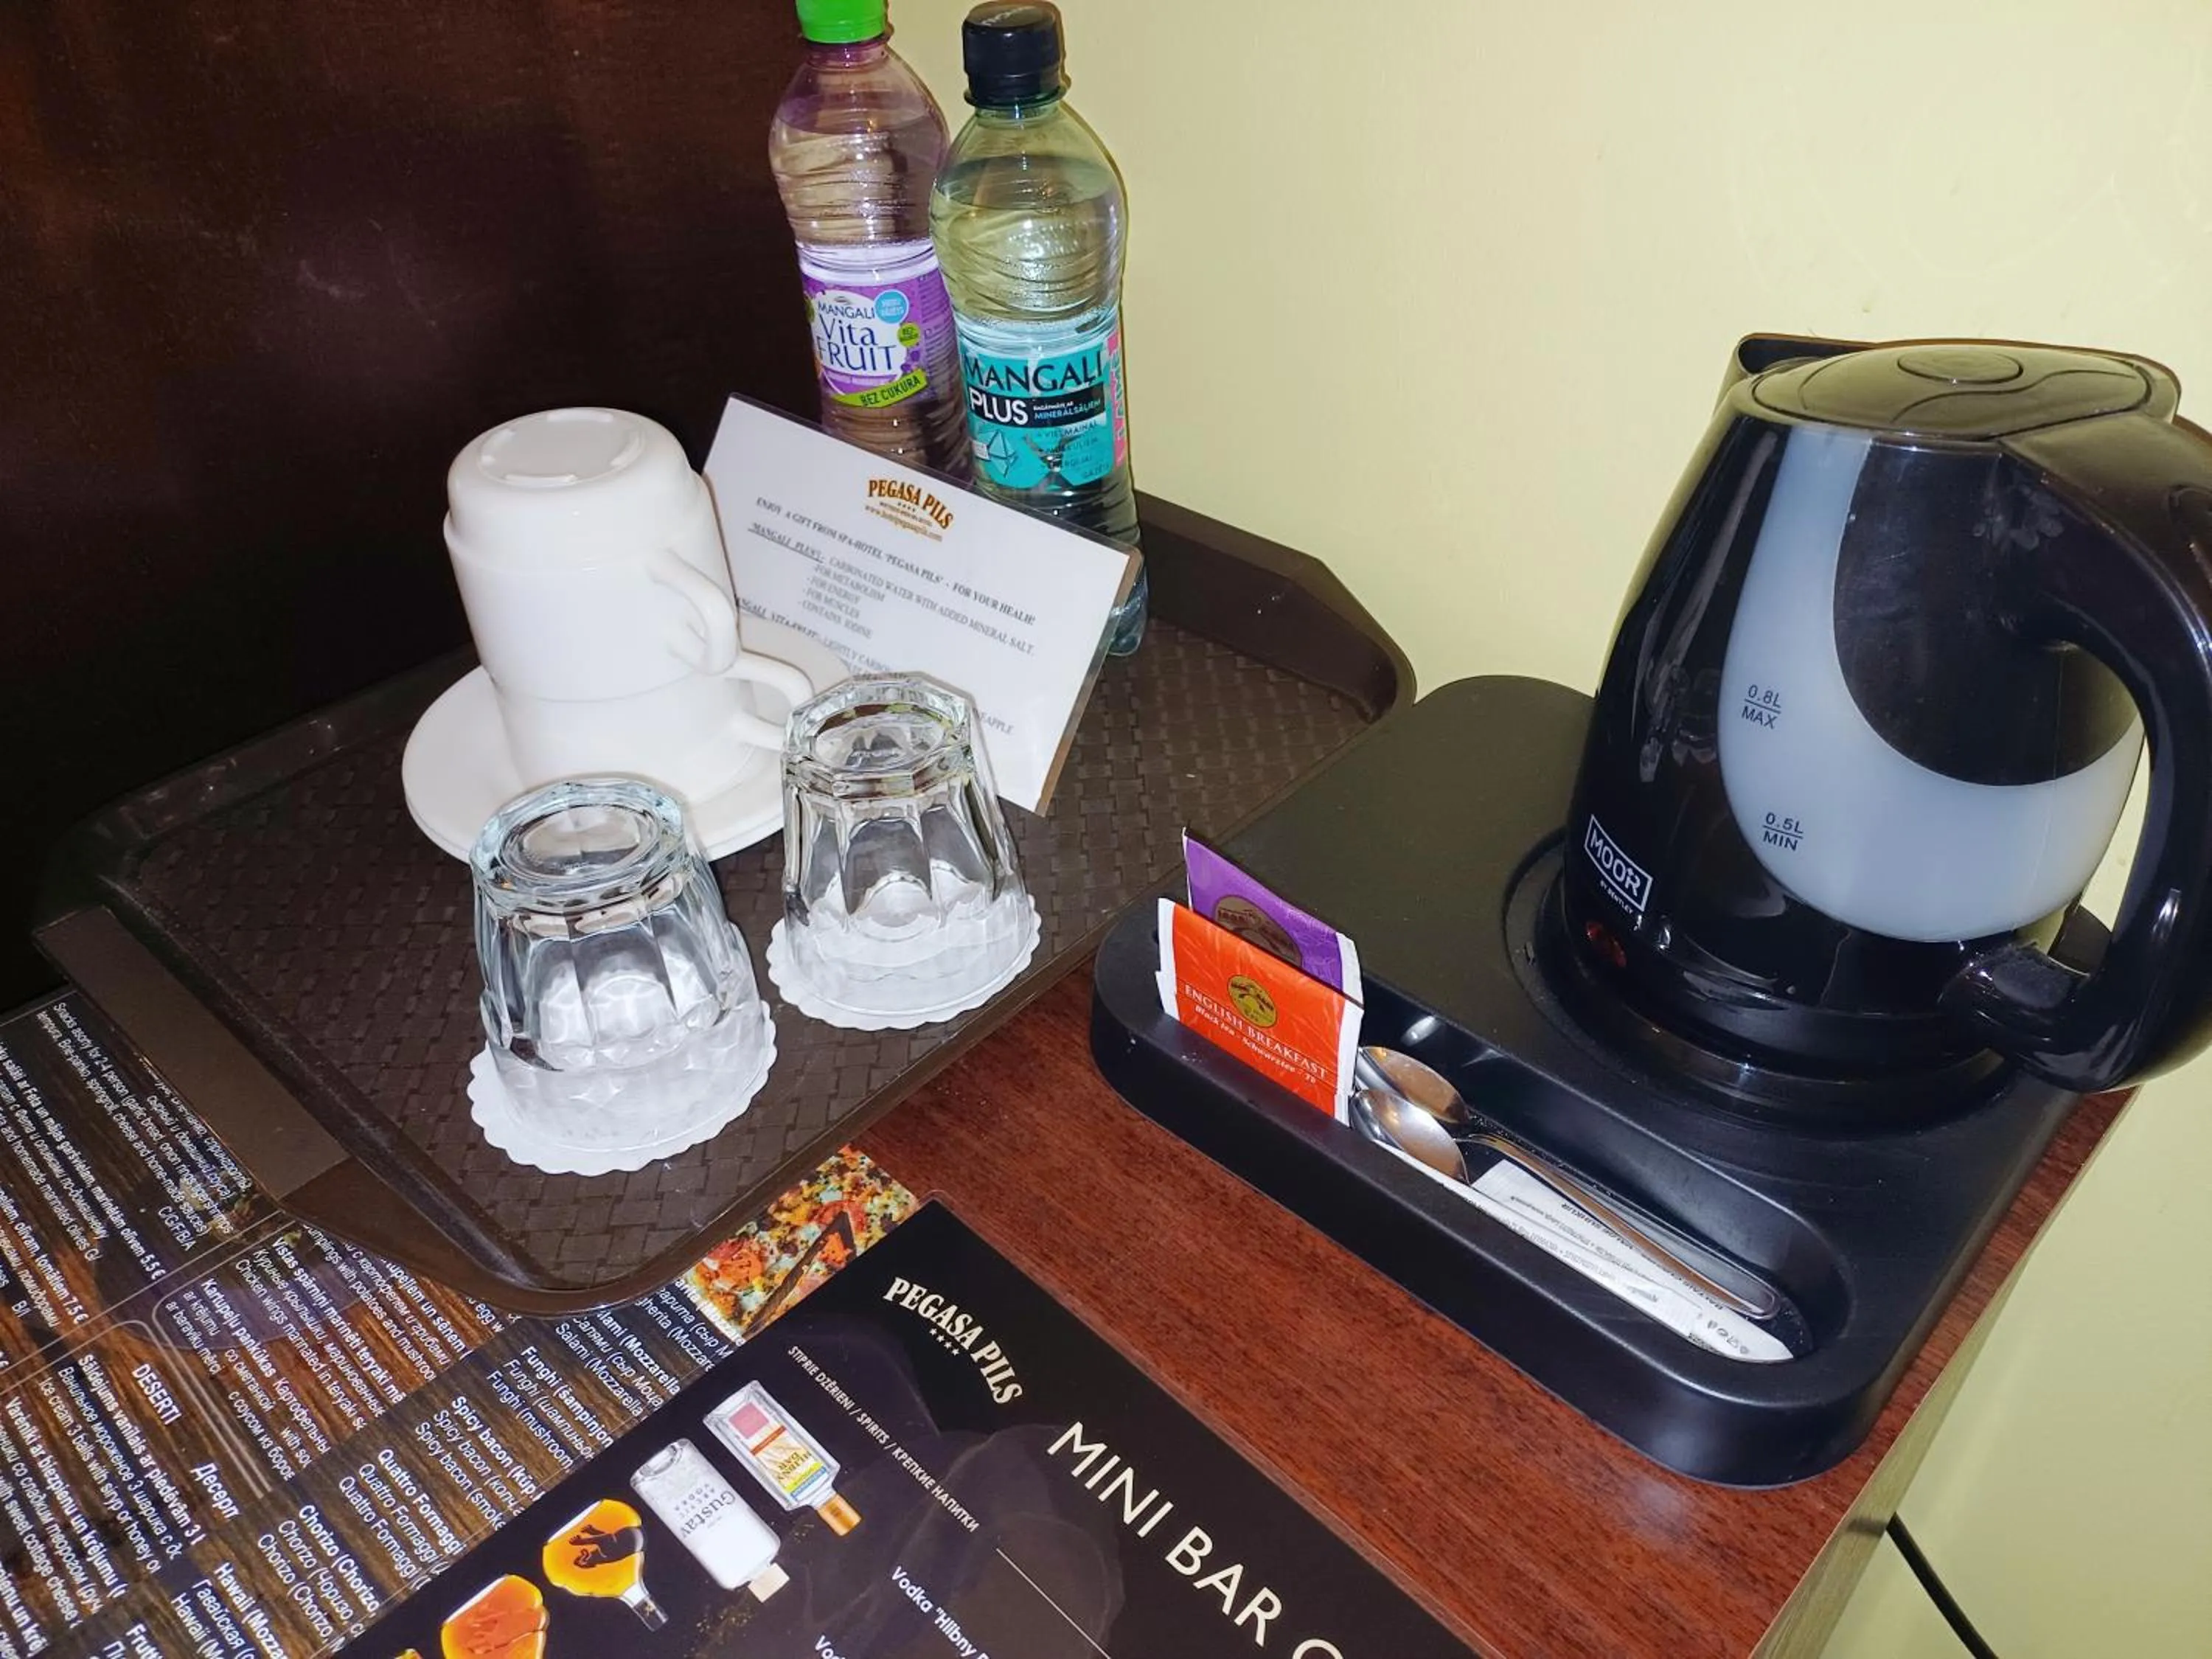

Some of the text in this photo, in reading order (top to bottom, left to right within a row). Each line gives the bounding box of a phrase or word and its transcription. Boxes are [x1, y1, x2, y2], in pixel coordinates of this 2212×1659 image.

[816, 300, 876, 320] MANGALI
[819, 315, 878, 347] Vita
[816, 335, 897, 372] FRUIT
[964, 351, 1103, 394] MANGALI
[859, 376, 922, 407] BEZ CUKURA
[969, 389, 1029, 425] PLUS
[869, 479, 922, 504] PEGASA
[922, 493, 953, 529] PILS
[757, 497, 781, 514] ENJOY
[792, 513, 812, 527] GIFT
[812, 521, 838, 539] FROM
[838, 533, 882, 559] SPA-HOTEL
[953, 582, 972, 597] FOR
[973, 591, 999, 610] YOUR
[885, 581, 914, 600] WATER
[915, 594, 938, 611] WITH
[938, 606, 968, 625] ADDED
[968, 619, 1007, 644] MINERAL
[1742, 705, 1778, 729] MAX
[1747, 684, 1781, 709] 0.8L
[1762, 831, 1798, 851] MIN
[1765, 812, 1804, 834] 0.5L
[1590, 828, 1642, 897] MOOR
[1184, 984, 1243, 1031] ENGLISH
[1248, 1022, 1328, 1081] BREAKFAST
[23, 1087, 42, 1108] Feta
[101, 1070, 129, 1096] person
[0, 1126, 19, 1142] and
[11, 1139, 46, 1185] homemade
[112, 1113, 139, 1142] cheese
[132, 1140, 153, 1157] and
[70, 1310, 90, 1326] €
[271, 1237, 299, 1269] Vistas
[356, 1346, 392, 1388] teryaki
[337, 1262, 404, 1339] with potatoes and
[420, 1301, 437, 1318] un
[232, 1326, 276, 1378] pankūkas
[235, 1259, 271, 1298] Chicken
[262, 1295, 288, 1325] wings
[282, 1323, 327, 1373] marinated
[325, 1380, 358, 1418] teryaki
[883, 1277, 1023, 1404] PEGASA PILS
[486, 1370, 526, 1411] Funghi
[503, 1359, 542, 1397] Funghi
[521, 1346, 563, 1388] Funghi
[555, 1322, 645, 1421] Salami (Mozzarella
[131, 1363, 182, 1425] DESERTI
[279, 1427, 301, 1450] with
[414, 1422, 473, 1491] Spicy bacon
[433, 1409, 492, 1477] Spicy bacon
[451, 1396, 513, 1468] Spicy bacon
[787, 1346, 820, 1376] STIPRIE
[815, 1371, 855, 1411] DZĒRIENI
[856, 1413, 890, 1444] SPIRITS
[891, 1447, 936, 1489] КРЕПКИЕ
[931, 1485, 980, 1532] НАПИТКИ
[38, 1377, 56, 1397] Ice
[48, 1395, 74, 1428] cream
[72, 1433, 95, 1462] balls
[87, 1459, 109, 1484] with
[124, 1520, 154, 1561] honey
[70, 1514, 88, 1534] un
[358, 1463, 443, 1564] Quattro Formaggi
[378, 1449, 467, 1556] Quattro Formaggi
[680, 1489, 737, 1539] Gustav
[278, 1520, 318, 1568] Chorizo
[298, 1505, 340, 1557] Chorizo
[338, 1475, 422, 1585] Quattro Formaggi
[1047, 1422, 1281, 1648] MINI BAR
[4, 1499, 34, 1536] sweet
[46, 1576, 84, 1621] cheese
[257, 1534, 296, 1585] Chorizo
[213, 1562, 256, 1613] Hawaii
[891, 1566, 933, 1613] Vodka
[11, 1605, 32, 1628] un
[170, 1592, 212, 1642] Hawaii
